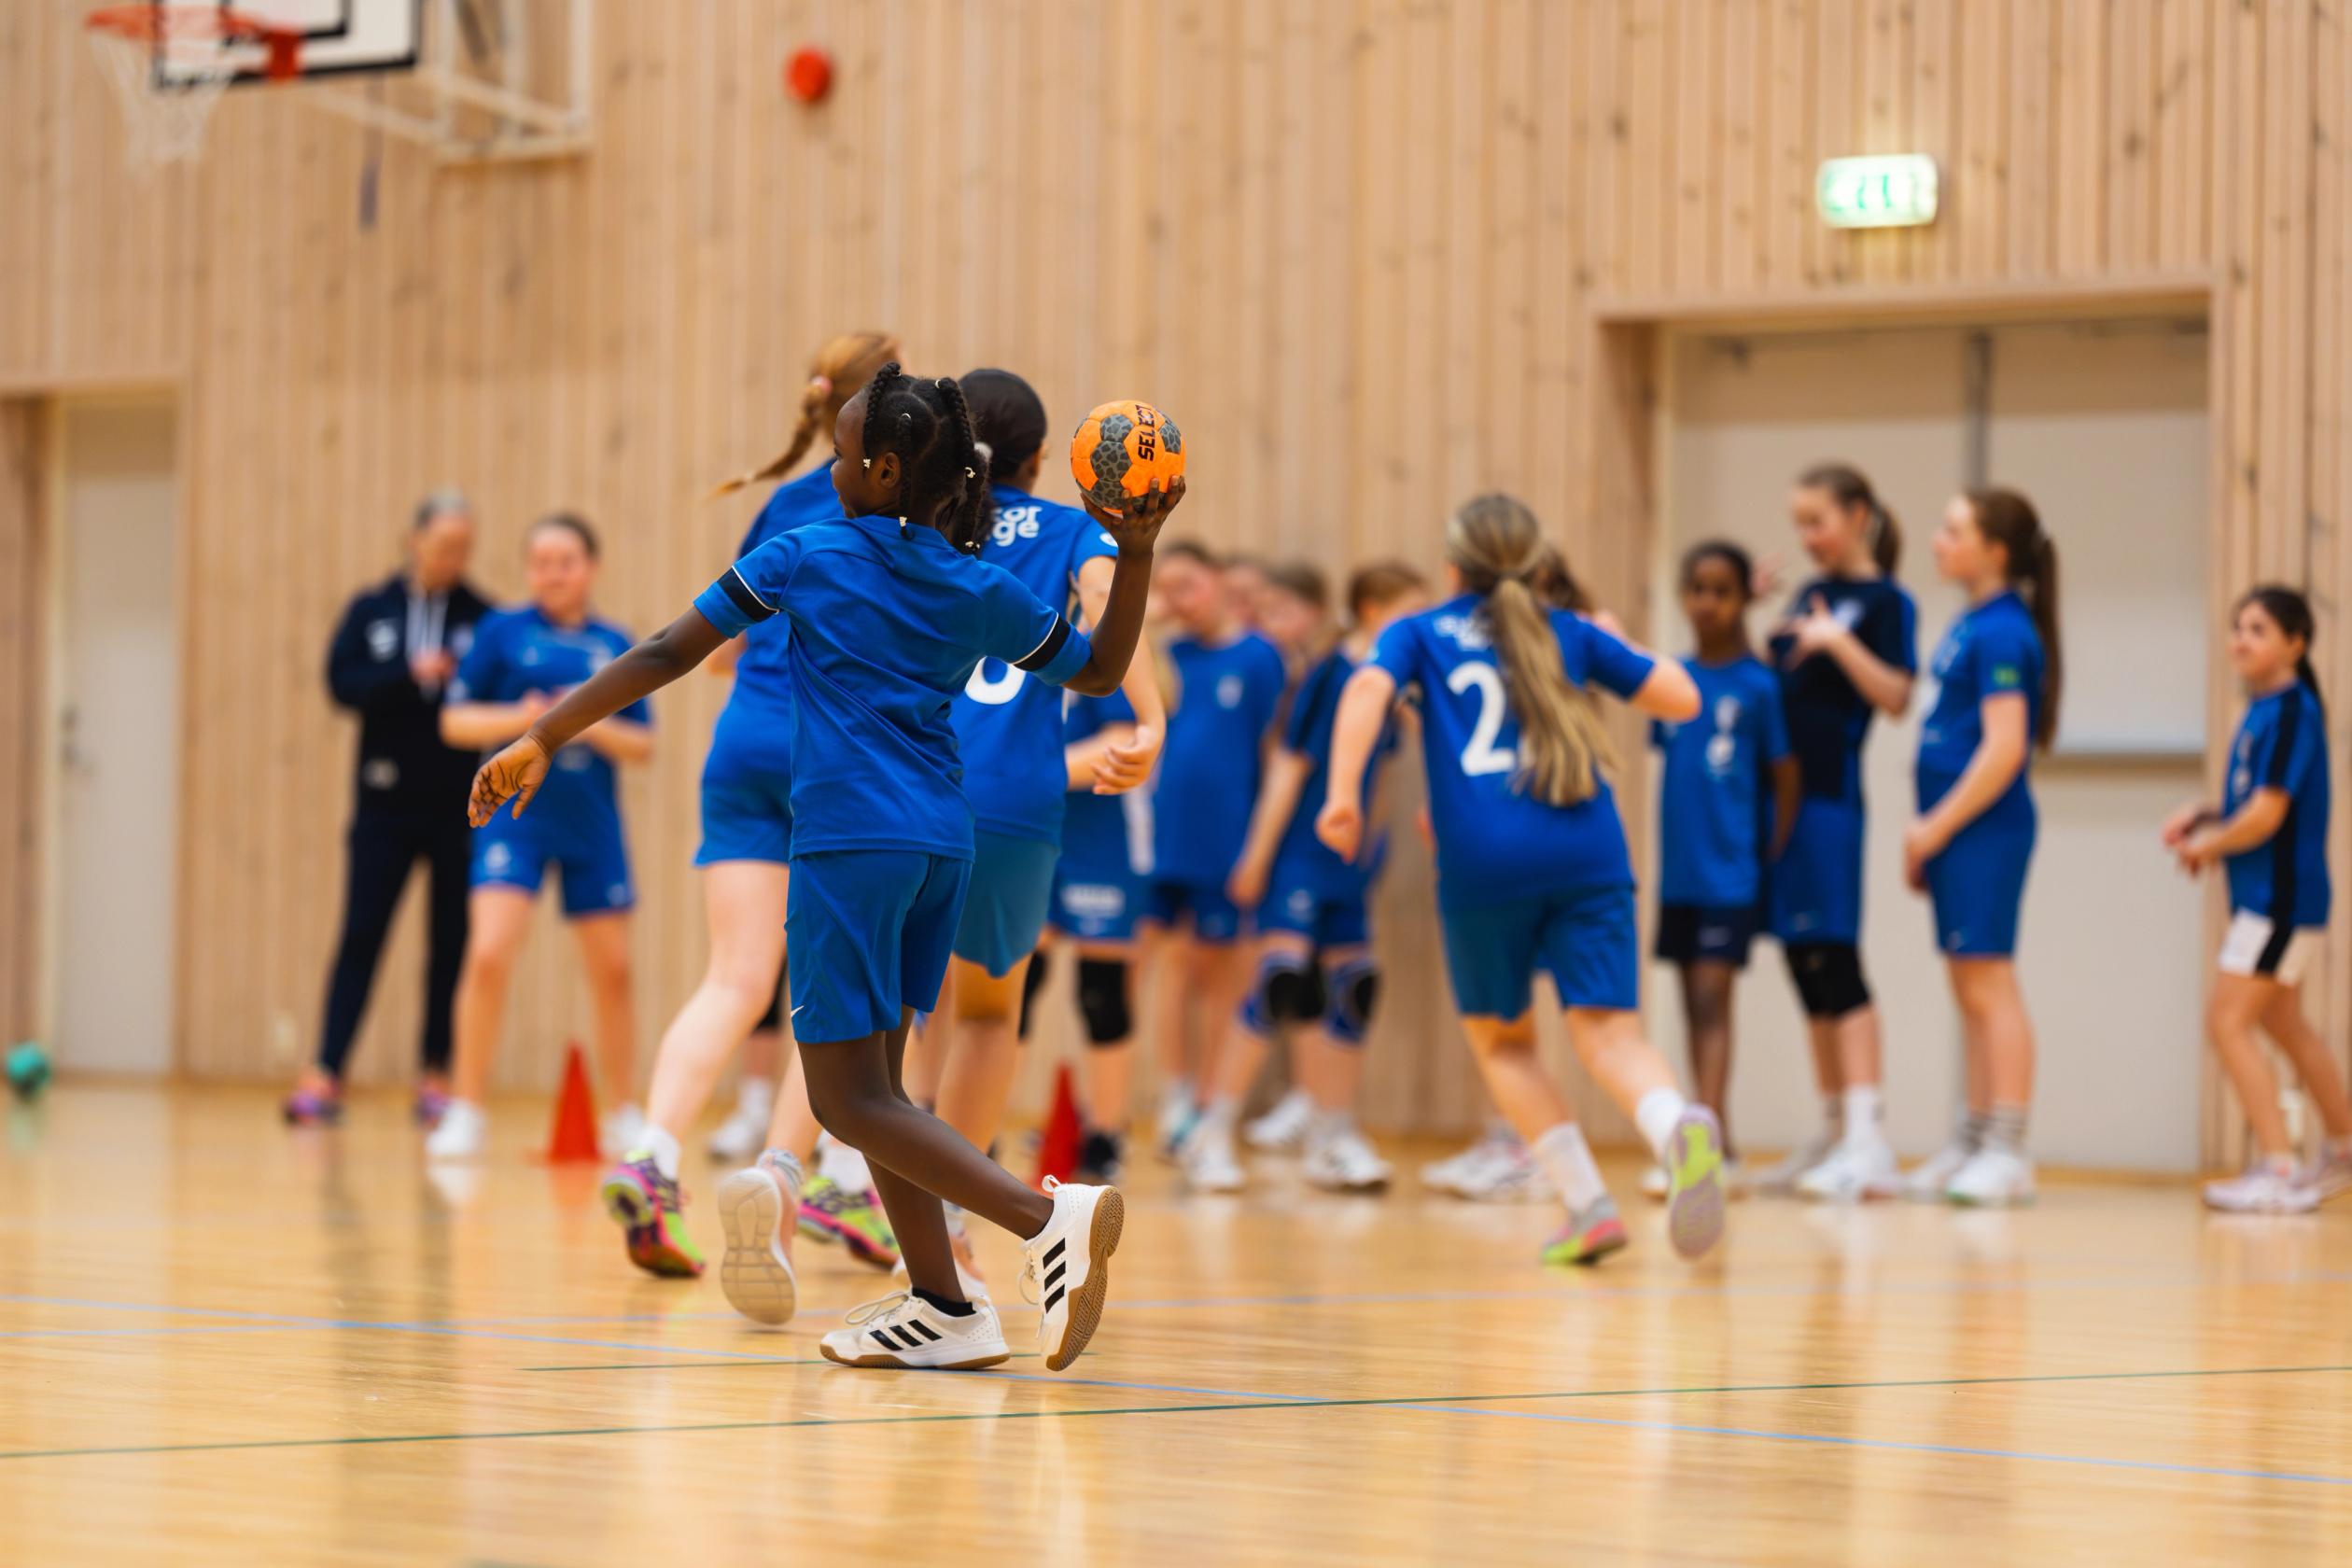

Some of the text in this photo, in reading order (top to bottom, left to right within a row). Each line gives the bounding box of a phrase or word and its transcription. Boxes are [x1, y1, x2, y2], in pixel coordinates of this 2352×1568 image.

[1135, 404, 1155, 462] SELECT
[989, 520, 1041, 547] ge
[1447, 660, 1533, 777] 2
